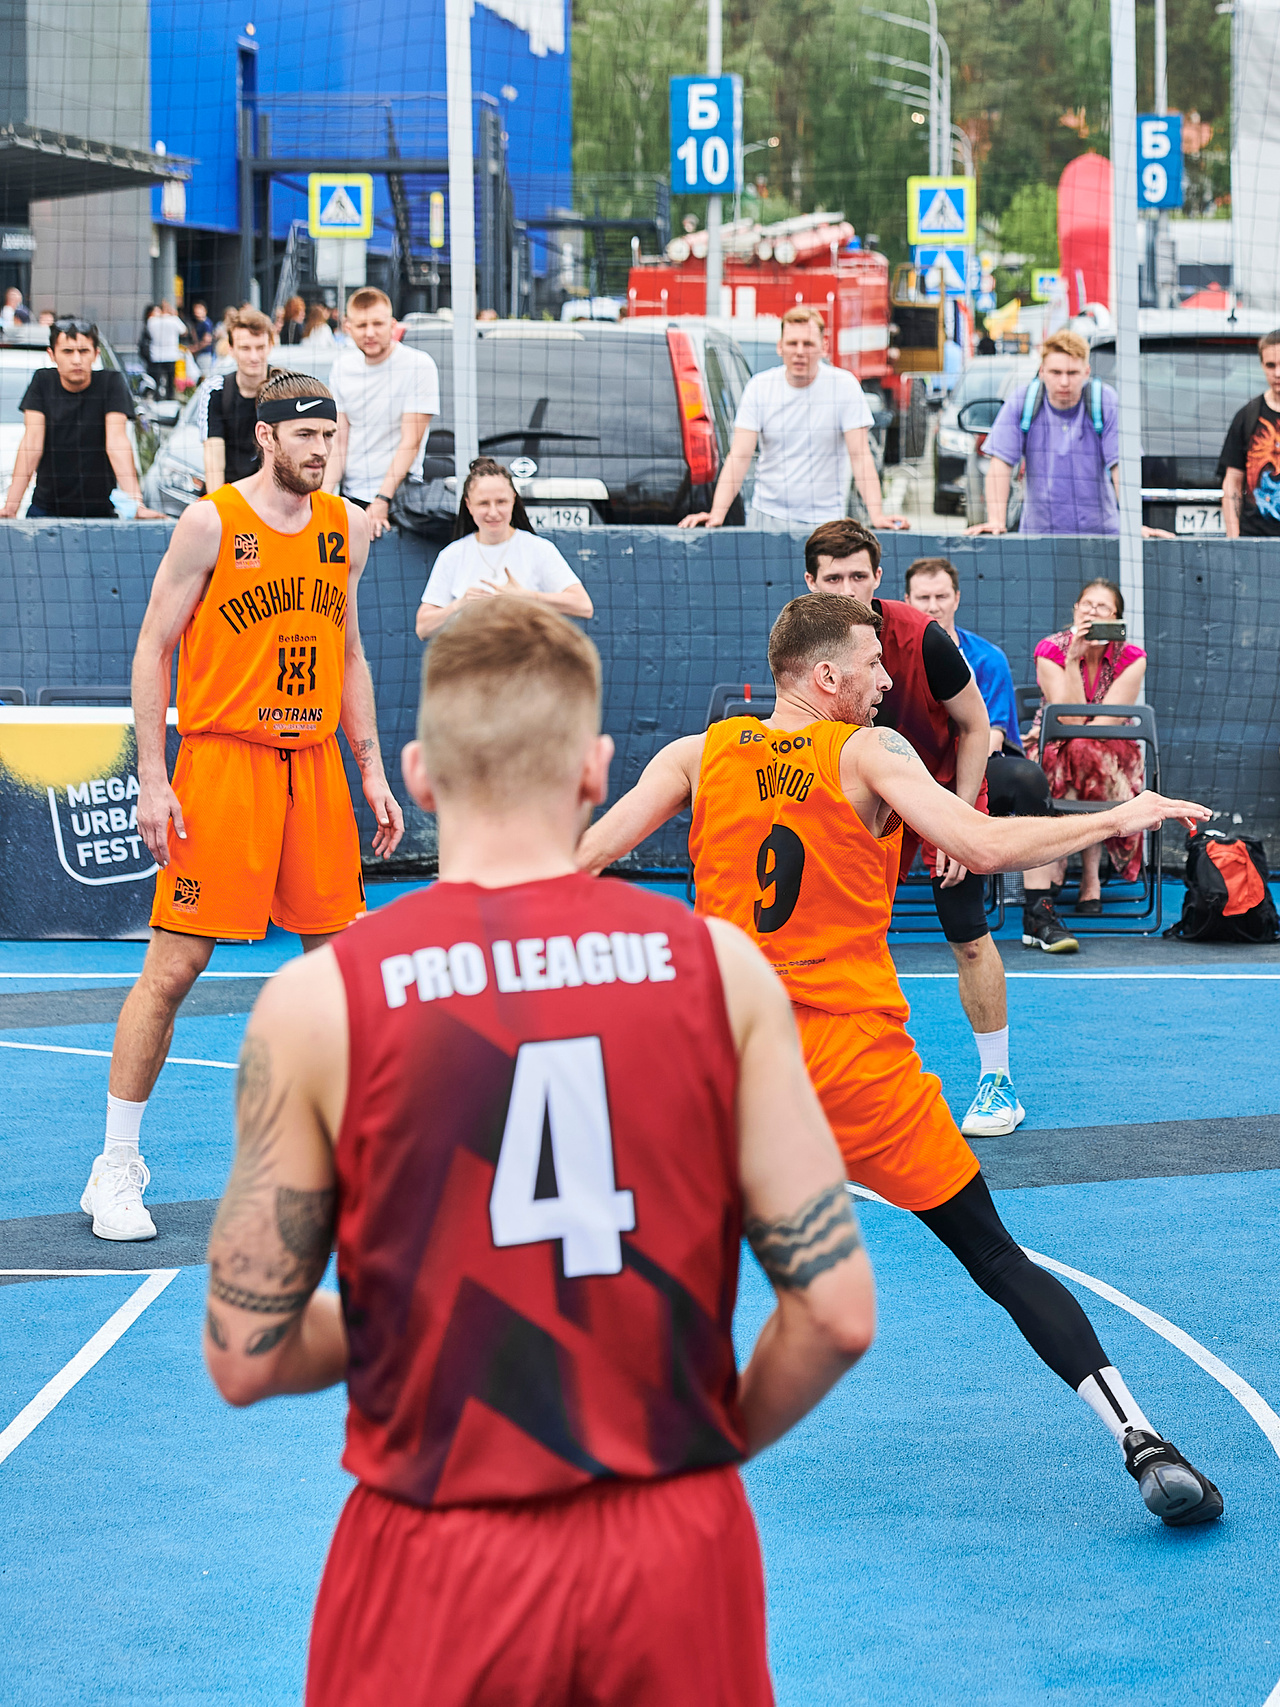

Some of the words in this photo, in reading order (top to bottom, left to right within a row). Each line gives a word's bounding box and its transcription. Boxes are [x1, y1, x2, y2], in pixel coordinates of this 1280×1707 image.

[687, 83, 720, 130] Б
[1141, 120, 1171, 159] Б
[677, 136, 729, 185] 10
[1142, 162, 1168, 203] 9
[553, 510, 583, 526] 196
[317, 531, 347, 564] 12
[218, 576, 307, 635] ГРЯЗНЫЕ
[66, 774, 140, 808] MEGA
[70, 804, 138, 837] URBA
[76, 834, 143, 868] FEST
[753, 823, 805, 934] 9
[380, 941, 488, 1009] PRO
[491, 930, 677, 994] LEAGUE
[489, 1034, 637, 1279] 4
